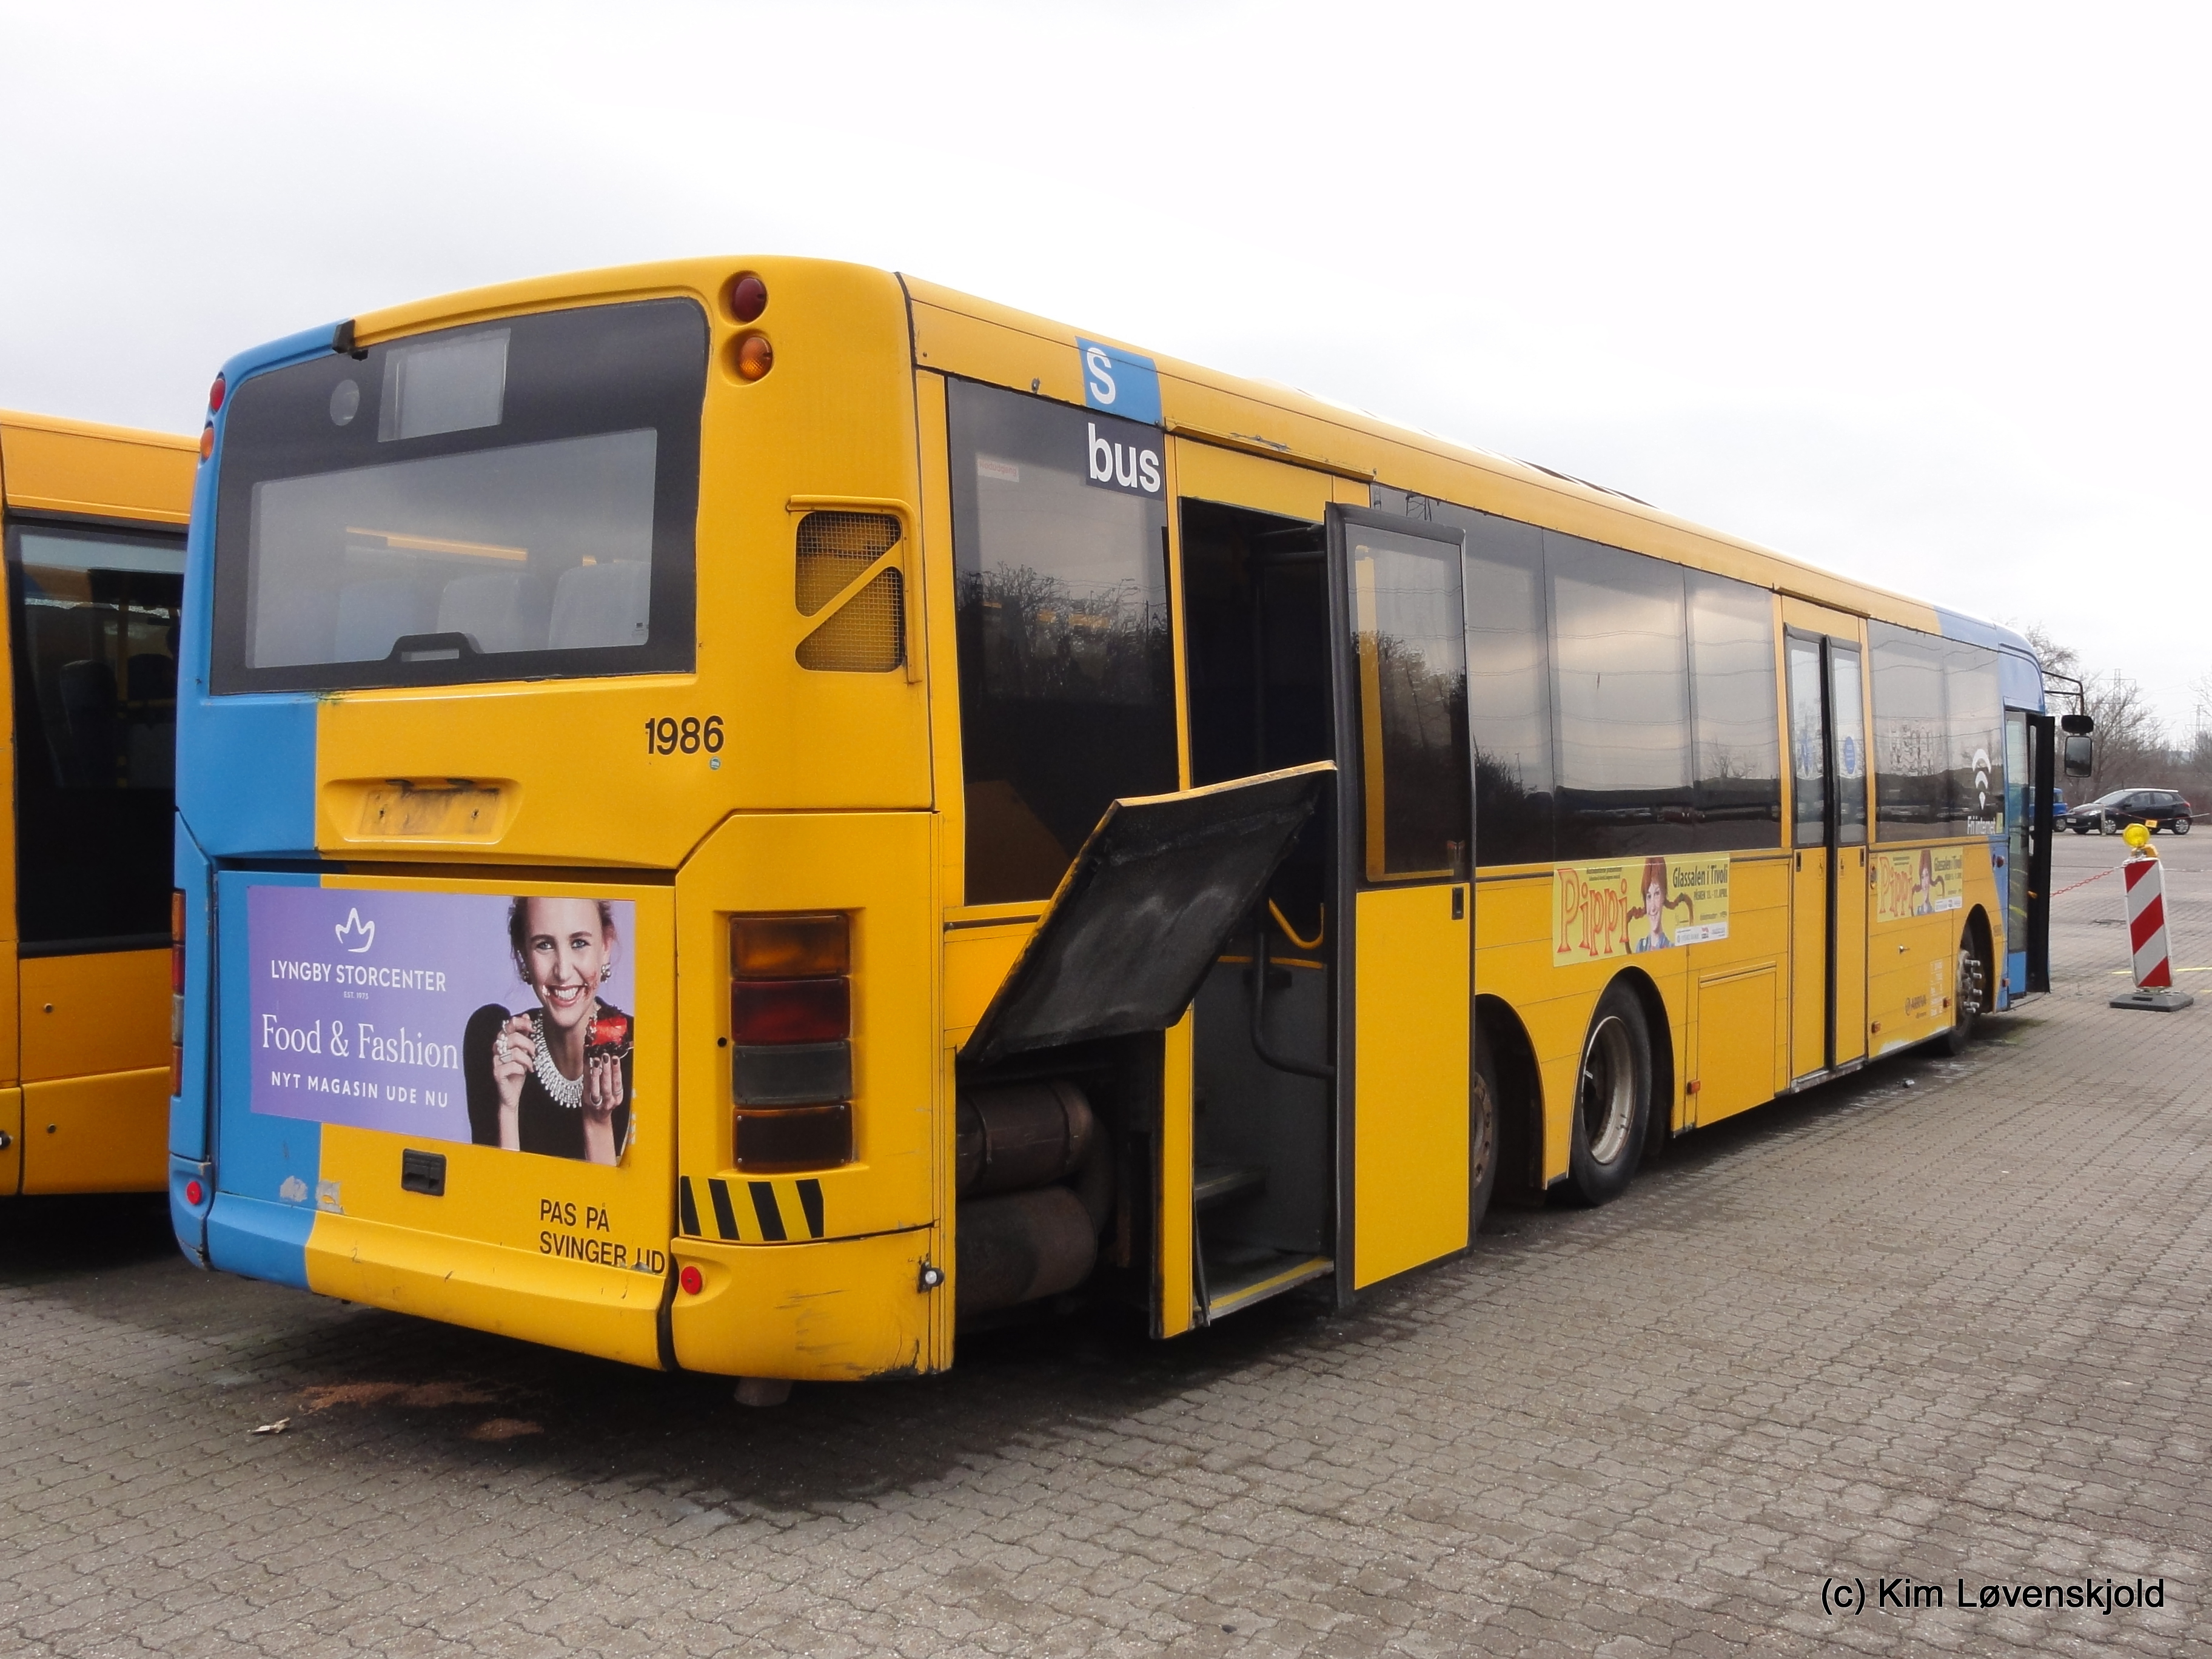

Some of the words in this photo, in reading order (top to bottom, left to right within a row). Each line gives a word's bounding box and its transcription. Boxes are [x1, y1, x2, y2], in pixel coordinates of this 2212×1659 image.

[1087, 347, 1116, 404] S
[1087, 422, 1161, 492] bus
[645, 715, 724, 755] 1986
[1672, 866, 1706, 888] Glassalen
[1706, 866, 1709, 885] i
[1711, 863, 1728, 884] Tivoli
[1557, 868, 1629, 956] Pippi
[271, 960, 332, 982] LYNGBY
[336, 964, 446, 991] STORCENTER
[262, 1014, 321, 1054] Food
[330, 1020, 349, 1057] &
[358, 1023, 458, 1070] Fashion
[272, 1071, 301, 1088] NYT
[308, 1075, 378, 1099] MAGASIN
[386, 1085, 417, 1104] UDE
[426, 1090, 447, 1107] NU
[540, 1198, 577, 1227] PAS
[586, 1202, 610, 1233] PÅ
[539, 1230, 627, 1267] SVINGER
[637, 1247, 665, 1275] UD
